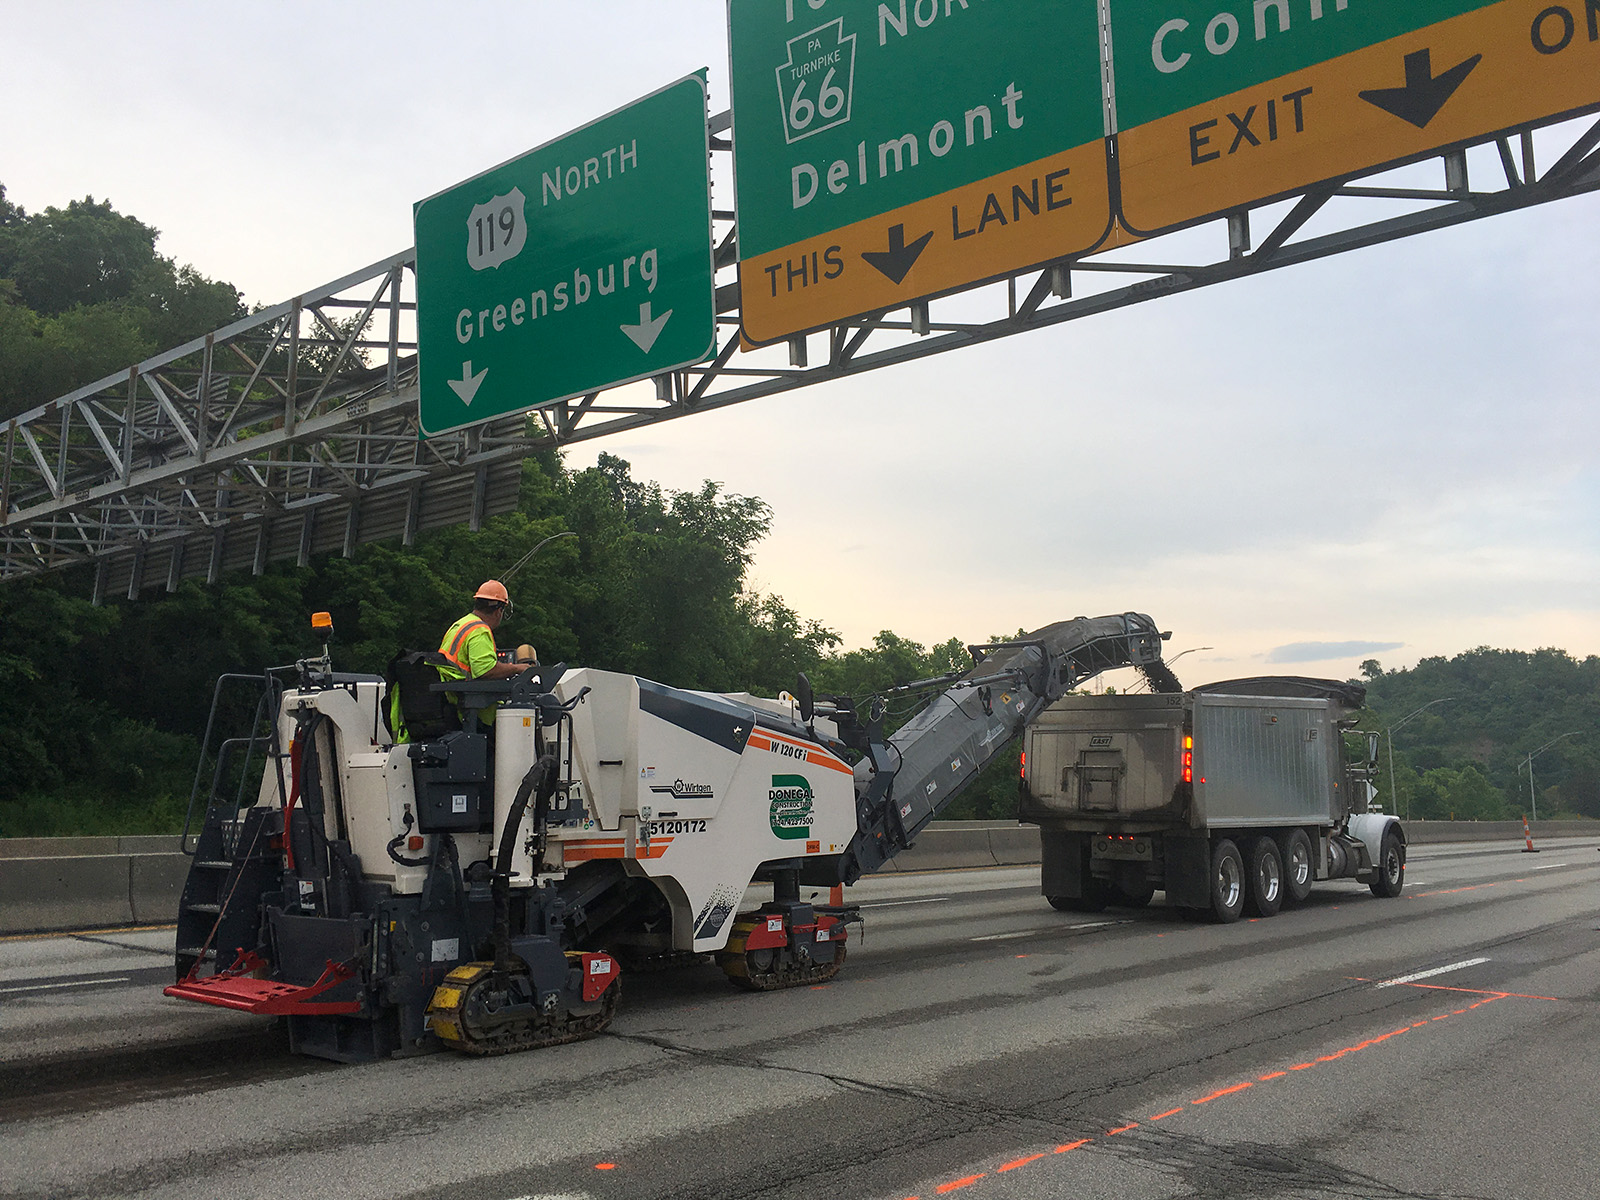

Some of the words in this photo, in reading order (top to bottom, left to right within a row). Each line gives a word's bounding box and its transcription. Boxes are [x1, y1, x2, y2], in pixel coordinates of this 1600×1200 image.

[808, 38, 821, 53] PA
[790, 49, 841, 80] TURNPIKE
[789, 66, 844, 130] 66
[1189, 87, 1313, 166] EXIT
[791, 81, 1024, 210] Delmont
[541, 139, 638, 206] NORTH
[475, 207, 515, 257] 119
[764, 245, 844, 298] THIS
[952, 168, 1072, 241] LANE
[456, 248, 658, 344] Greensburg
[1166, 696, 1180, 705] 152
[771, 741, 780, 753] W
[780, 744, 794, 757] 120
[684, 783, 711, 794] Wirtgen
[768, 789, 815, 800] DONEGAL
[771, 801, 813, 809] CONSTRUCTION
[650, 820, 706, 835] 5120172
